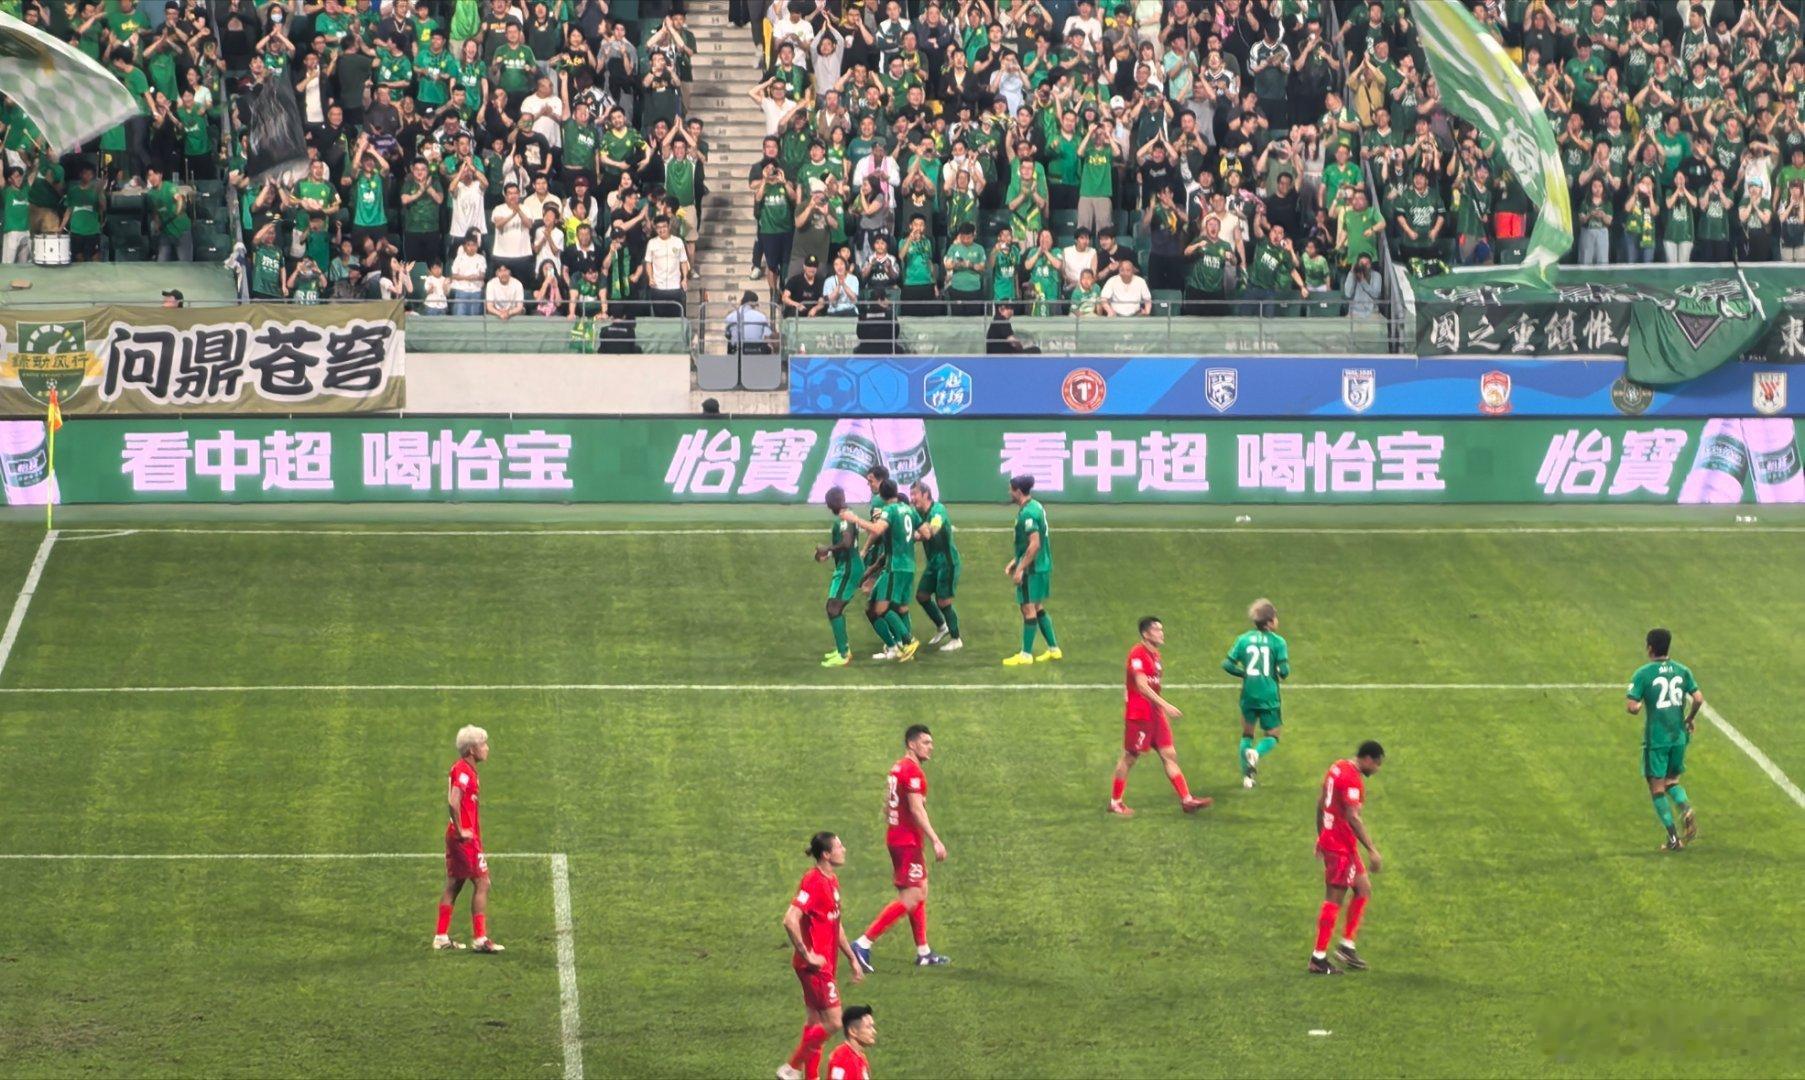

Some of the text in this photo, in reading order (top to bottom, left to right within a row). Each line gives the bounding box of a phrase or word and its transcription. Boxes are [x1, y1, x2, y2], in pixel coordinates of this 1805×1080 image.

[103, 322, 394, 400] 问鼎苍穹
[122, 429, 574, 491] 看中超 喝怡宝
[664, 428, 818, 495] 怡寶
[999, 430, 1446, 493] 看中超 喝怡宝
[1535, 428, 1688, 496] 怡寶
[903, 513, 913, 543] 9
[1246, 644, 1270, 677] 21
[1652, 675, 1683, 709] 26
